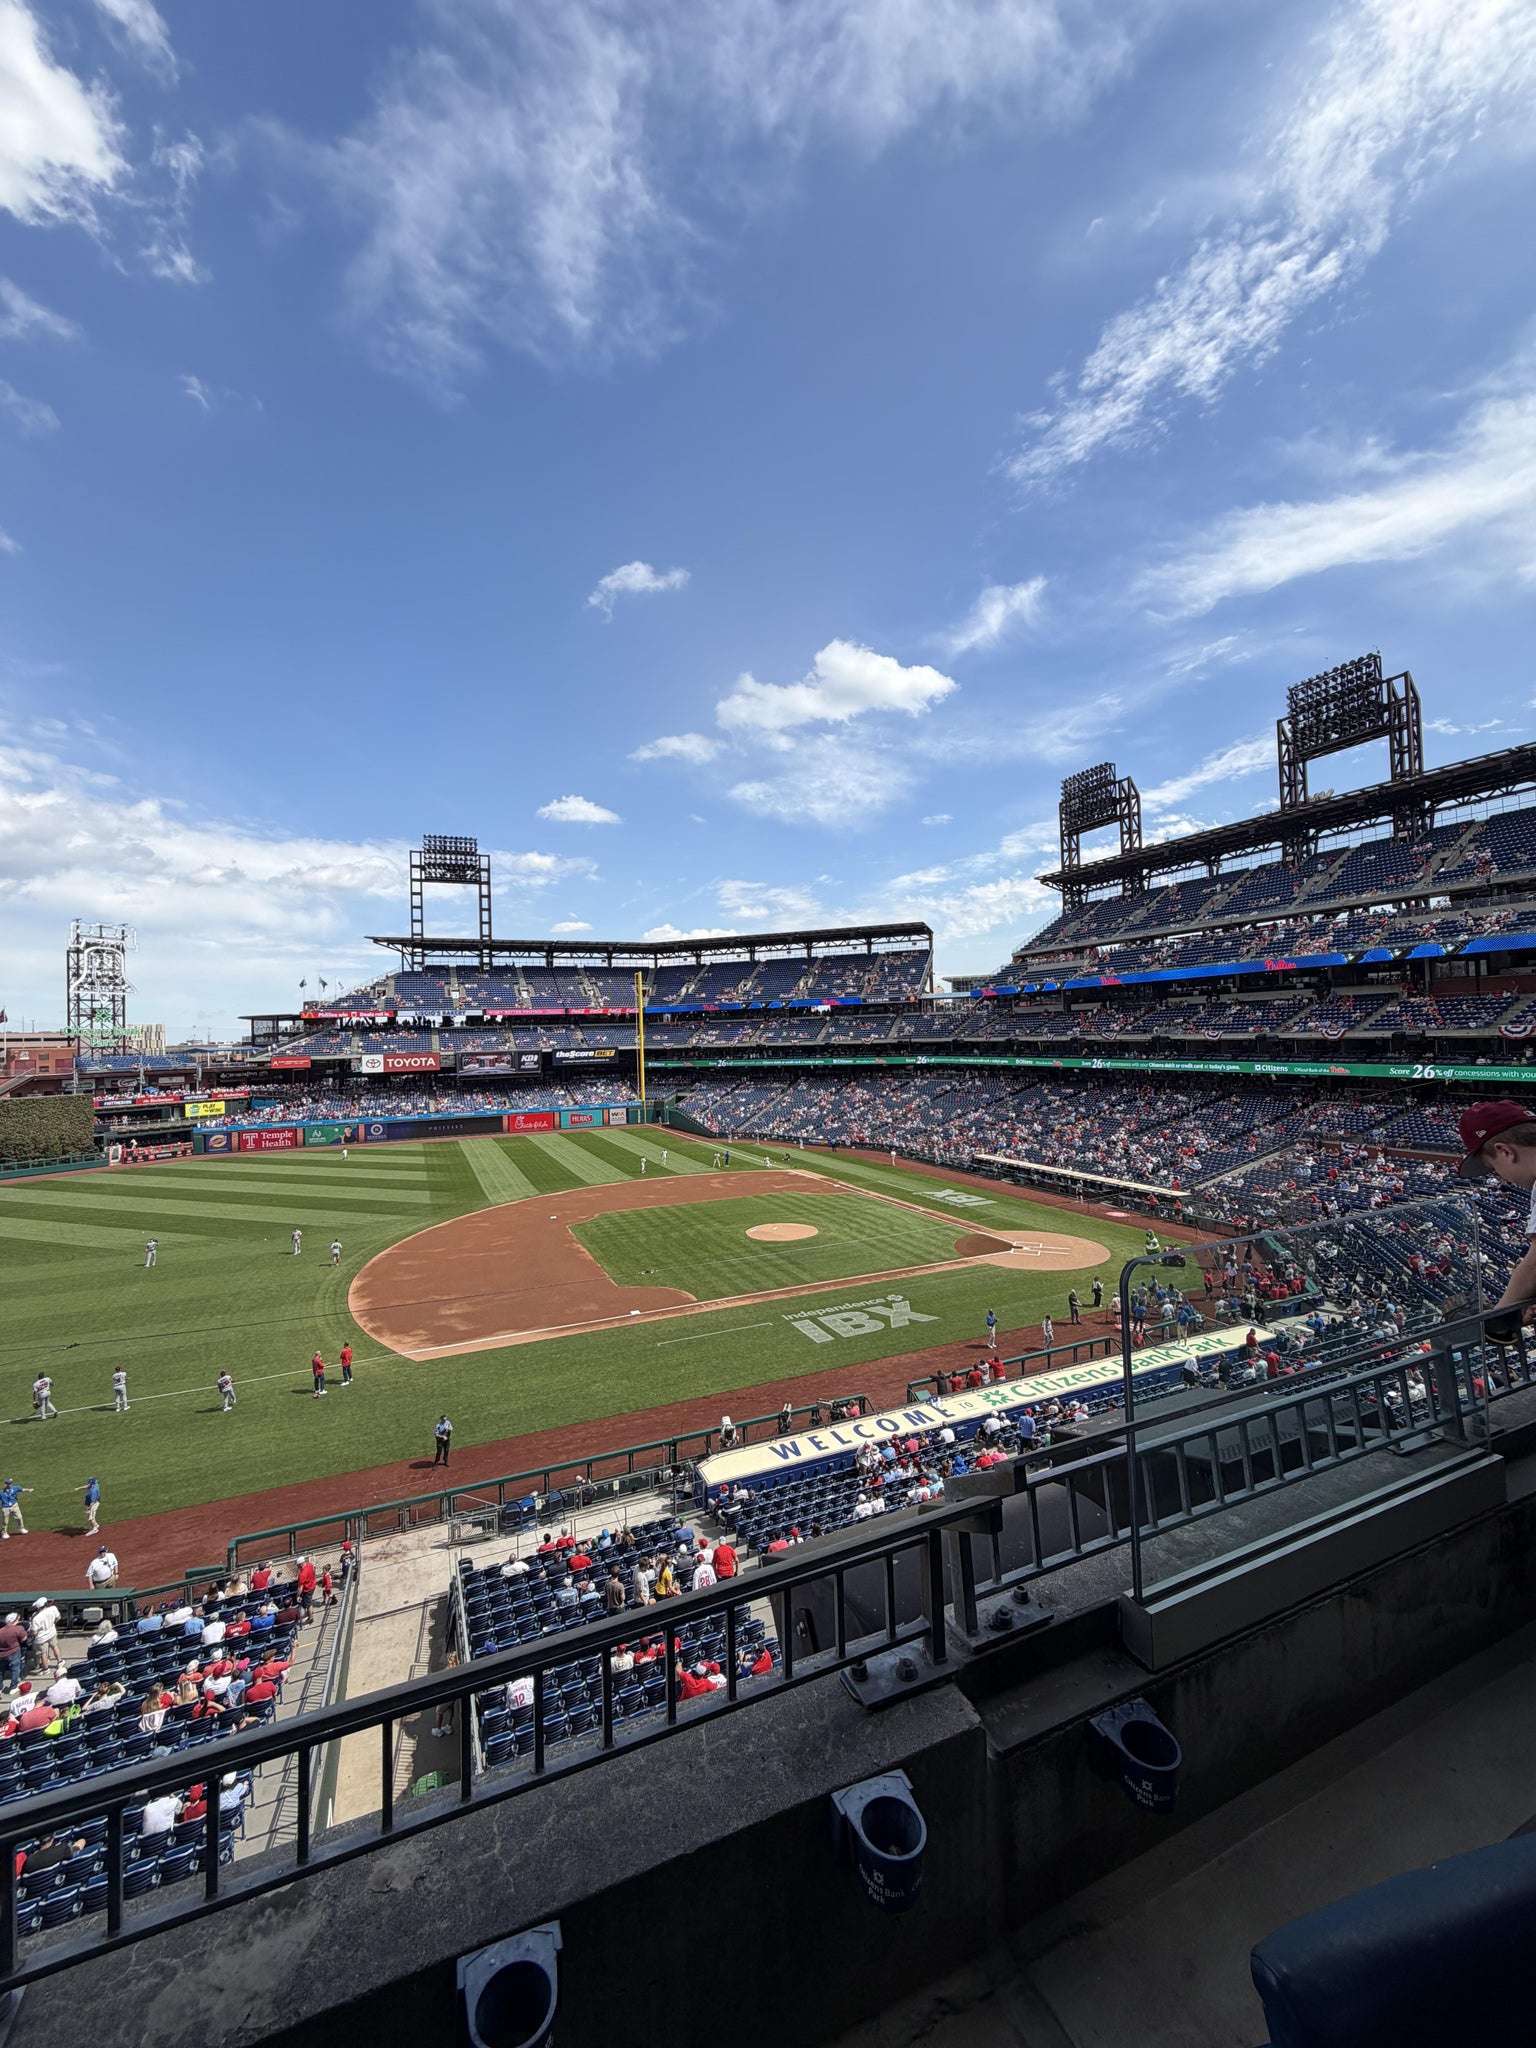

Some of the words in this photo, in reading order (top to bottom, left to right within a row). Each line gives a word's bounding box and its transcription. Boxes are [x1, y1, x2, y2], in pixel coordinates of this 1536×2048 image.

[1264, 960, 1297, 970] Phillies
[386, 1056, 436, 1068] TOYOTA
[916, 1056, 927, 1064] 26
[1261, 1064, 1289, 1072] Citizens
[1389, 1067, 1411, 1075] Score
[1454, 1068, 1501, 1077] concessions
[1502, 1068, 1519, 1078] with
[260, 1131, 294, 1141] Temple
[261, 1139, 292, 1148] Health
[781, 1296, 886, 1321] Independence
[791, 1300, 941, 1344] IBX
[1010, 1364, 1120, 1398] Citizens
[768, 1402, 956, 1460] WELCOME
[700, 1576, 711, 1588] 28
[514, 1692, 526, 1708] 12
